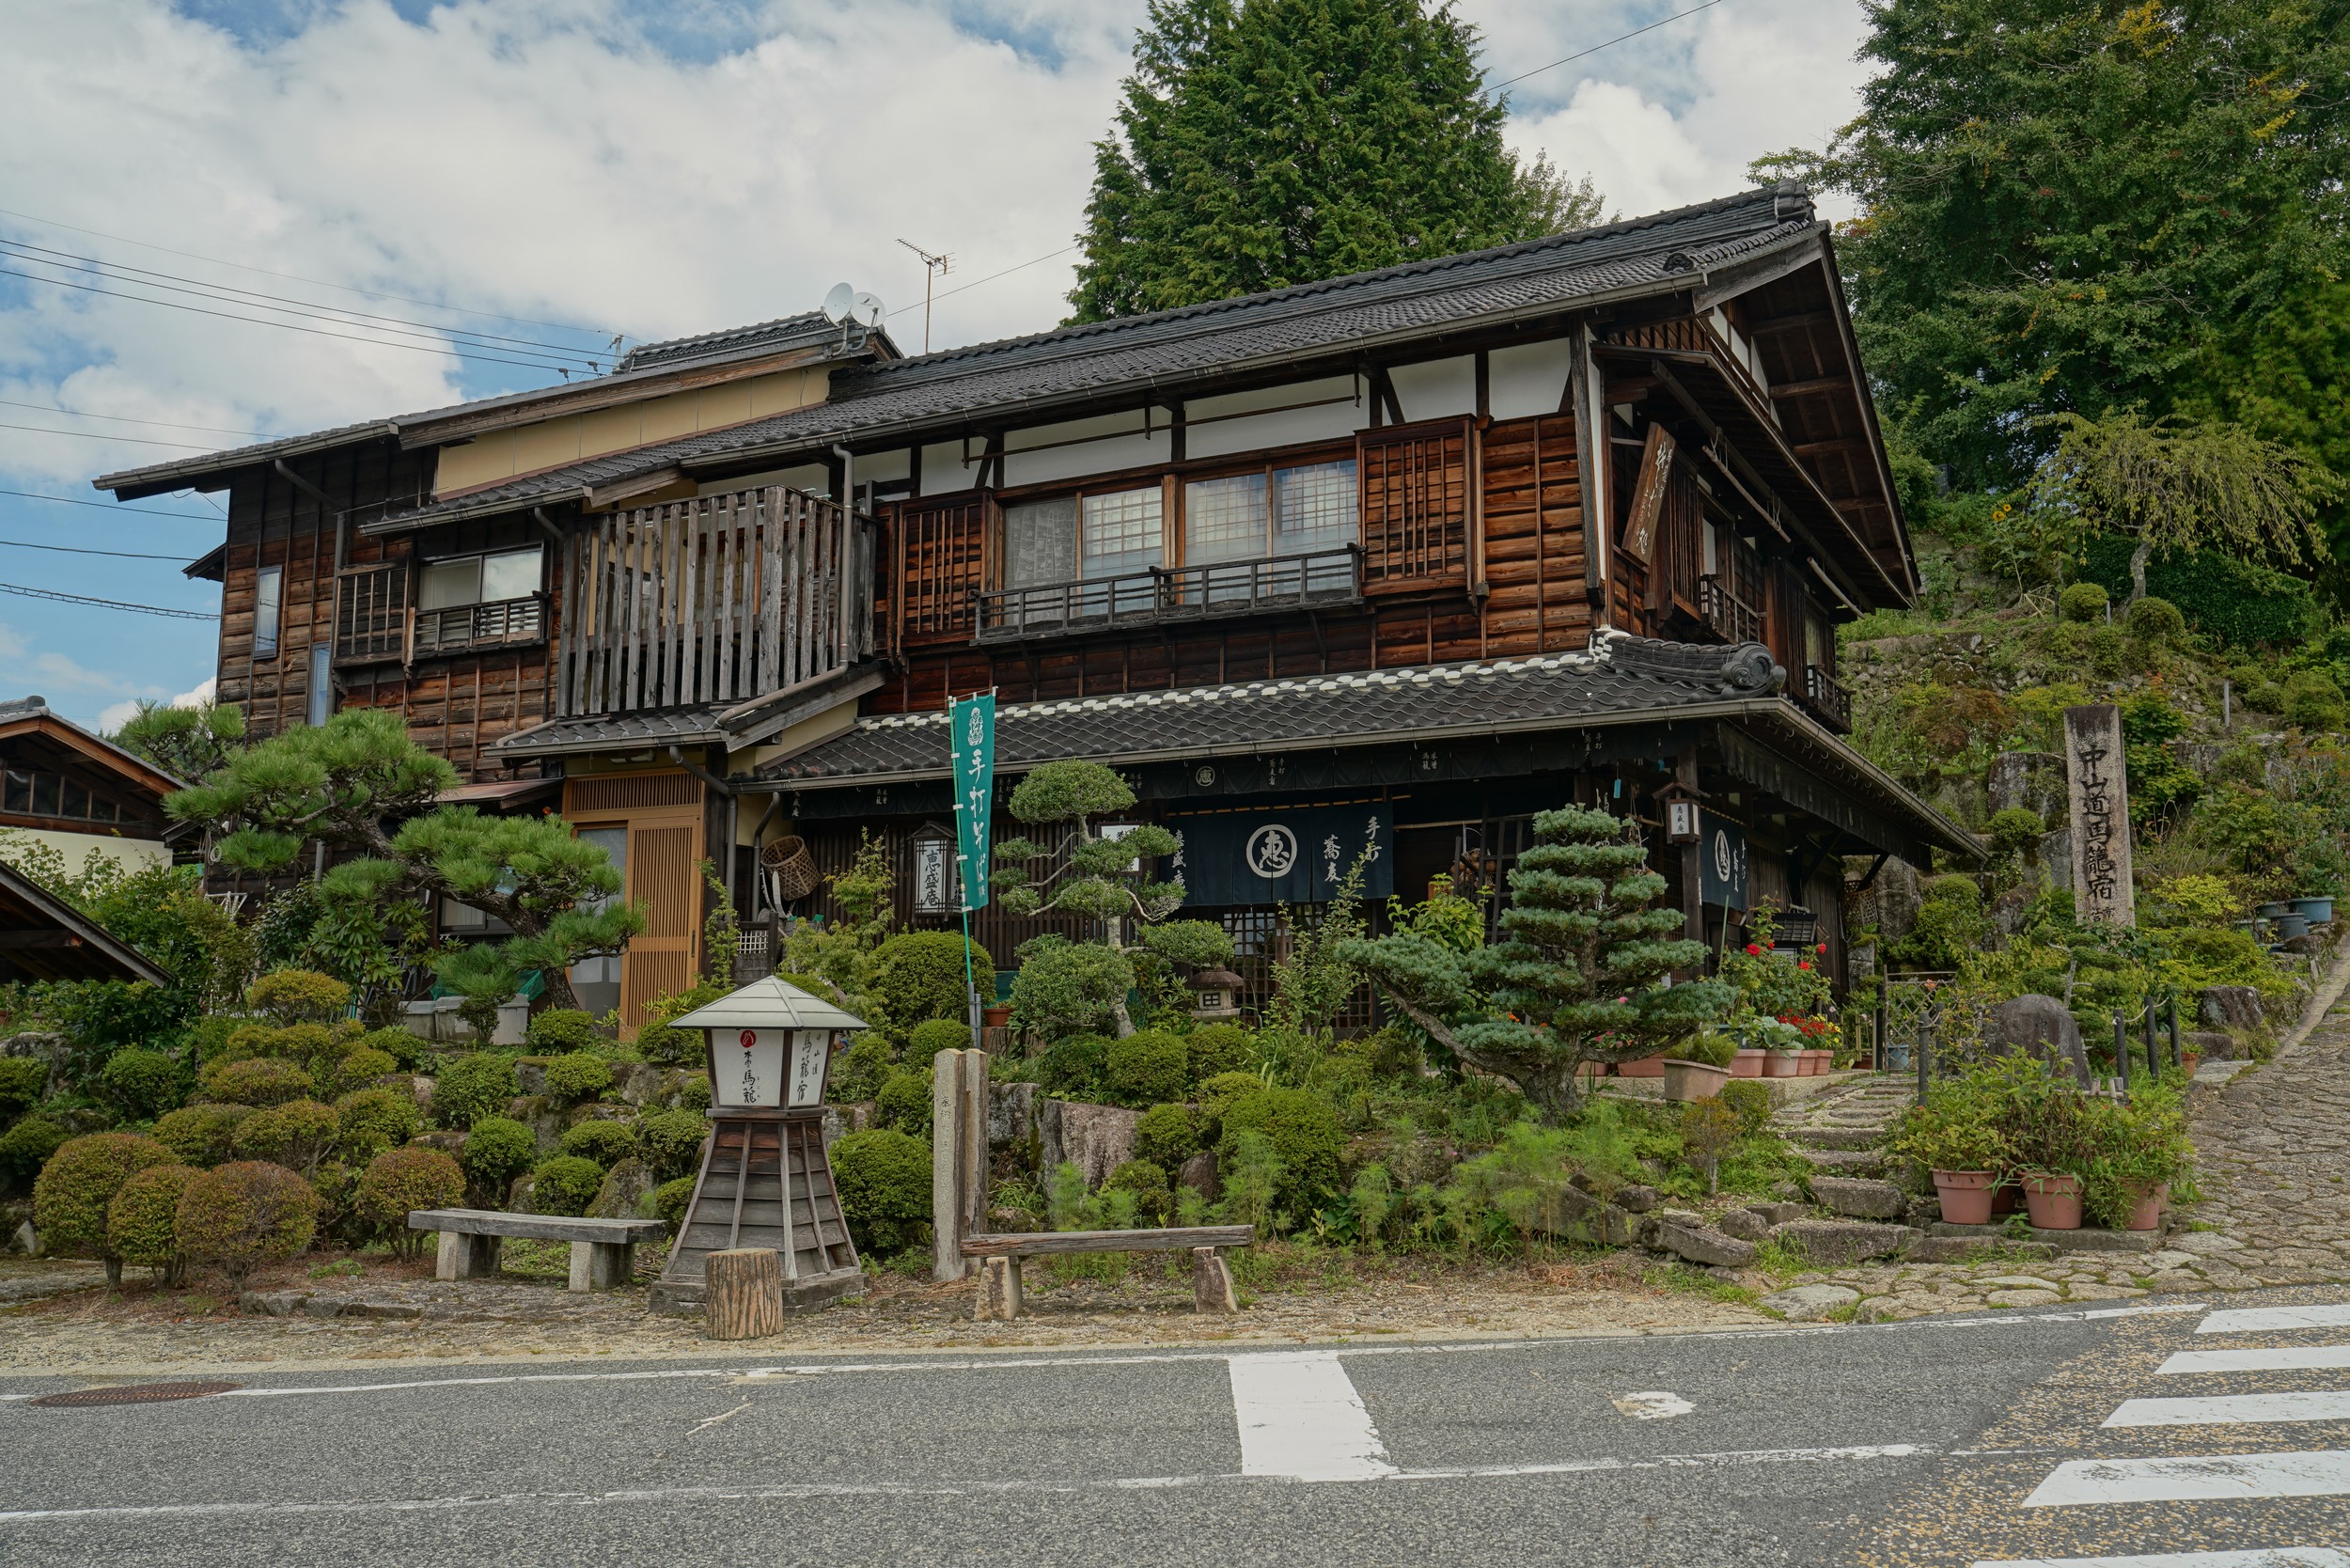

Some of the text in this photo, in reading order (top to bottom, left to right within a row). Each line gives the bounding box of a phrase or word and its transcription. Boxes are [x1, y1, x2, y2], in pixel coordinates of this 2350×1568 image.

[2078, 745, 2116, 901] 中山道馬籠宿
[923, 850, 941, 907] 恵盛庵
